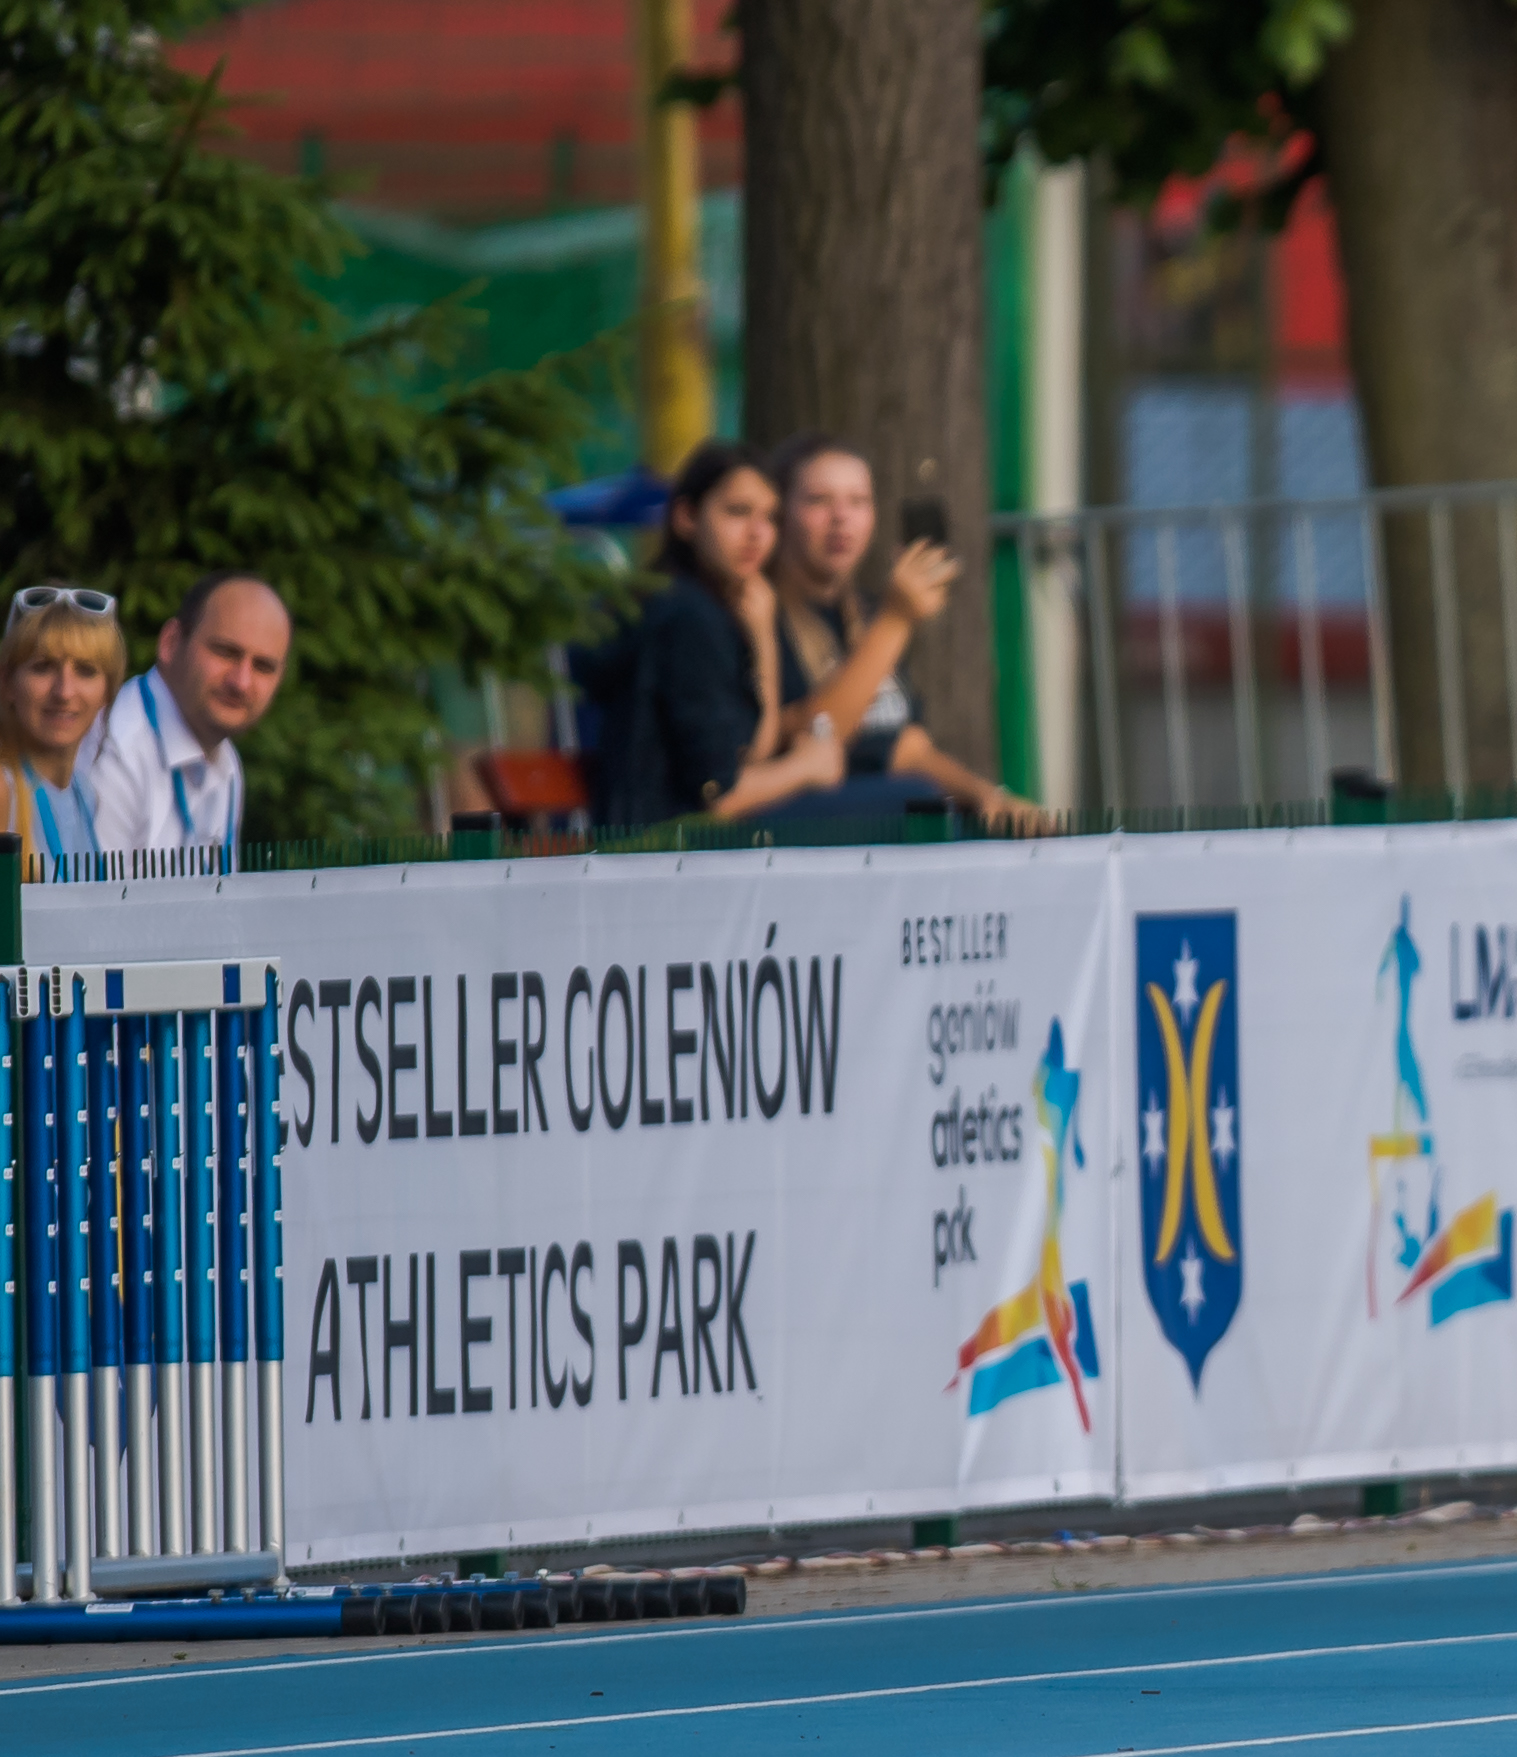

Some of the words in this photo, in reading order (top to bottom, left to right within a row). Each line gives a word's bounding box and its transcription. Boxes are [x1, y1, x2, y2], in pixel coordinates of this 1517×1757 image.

[279, 970, 549, 1148] STSELLER
[564, 922, 843, 1132] GOLENIÓW
[305, 1240, 596, 1424] ATHLETICS
[618, 1230, 758, 1400] PARK
